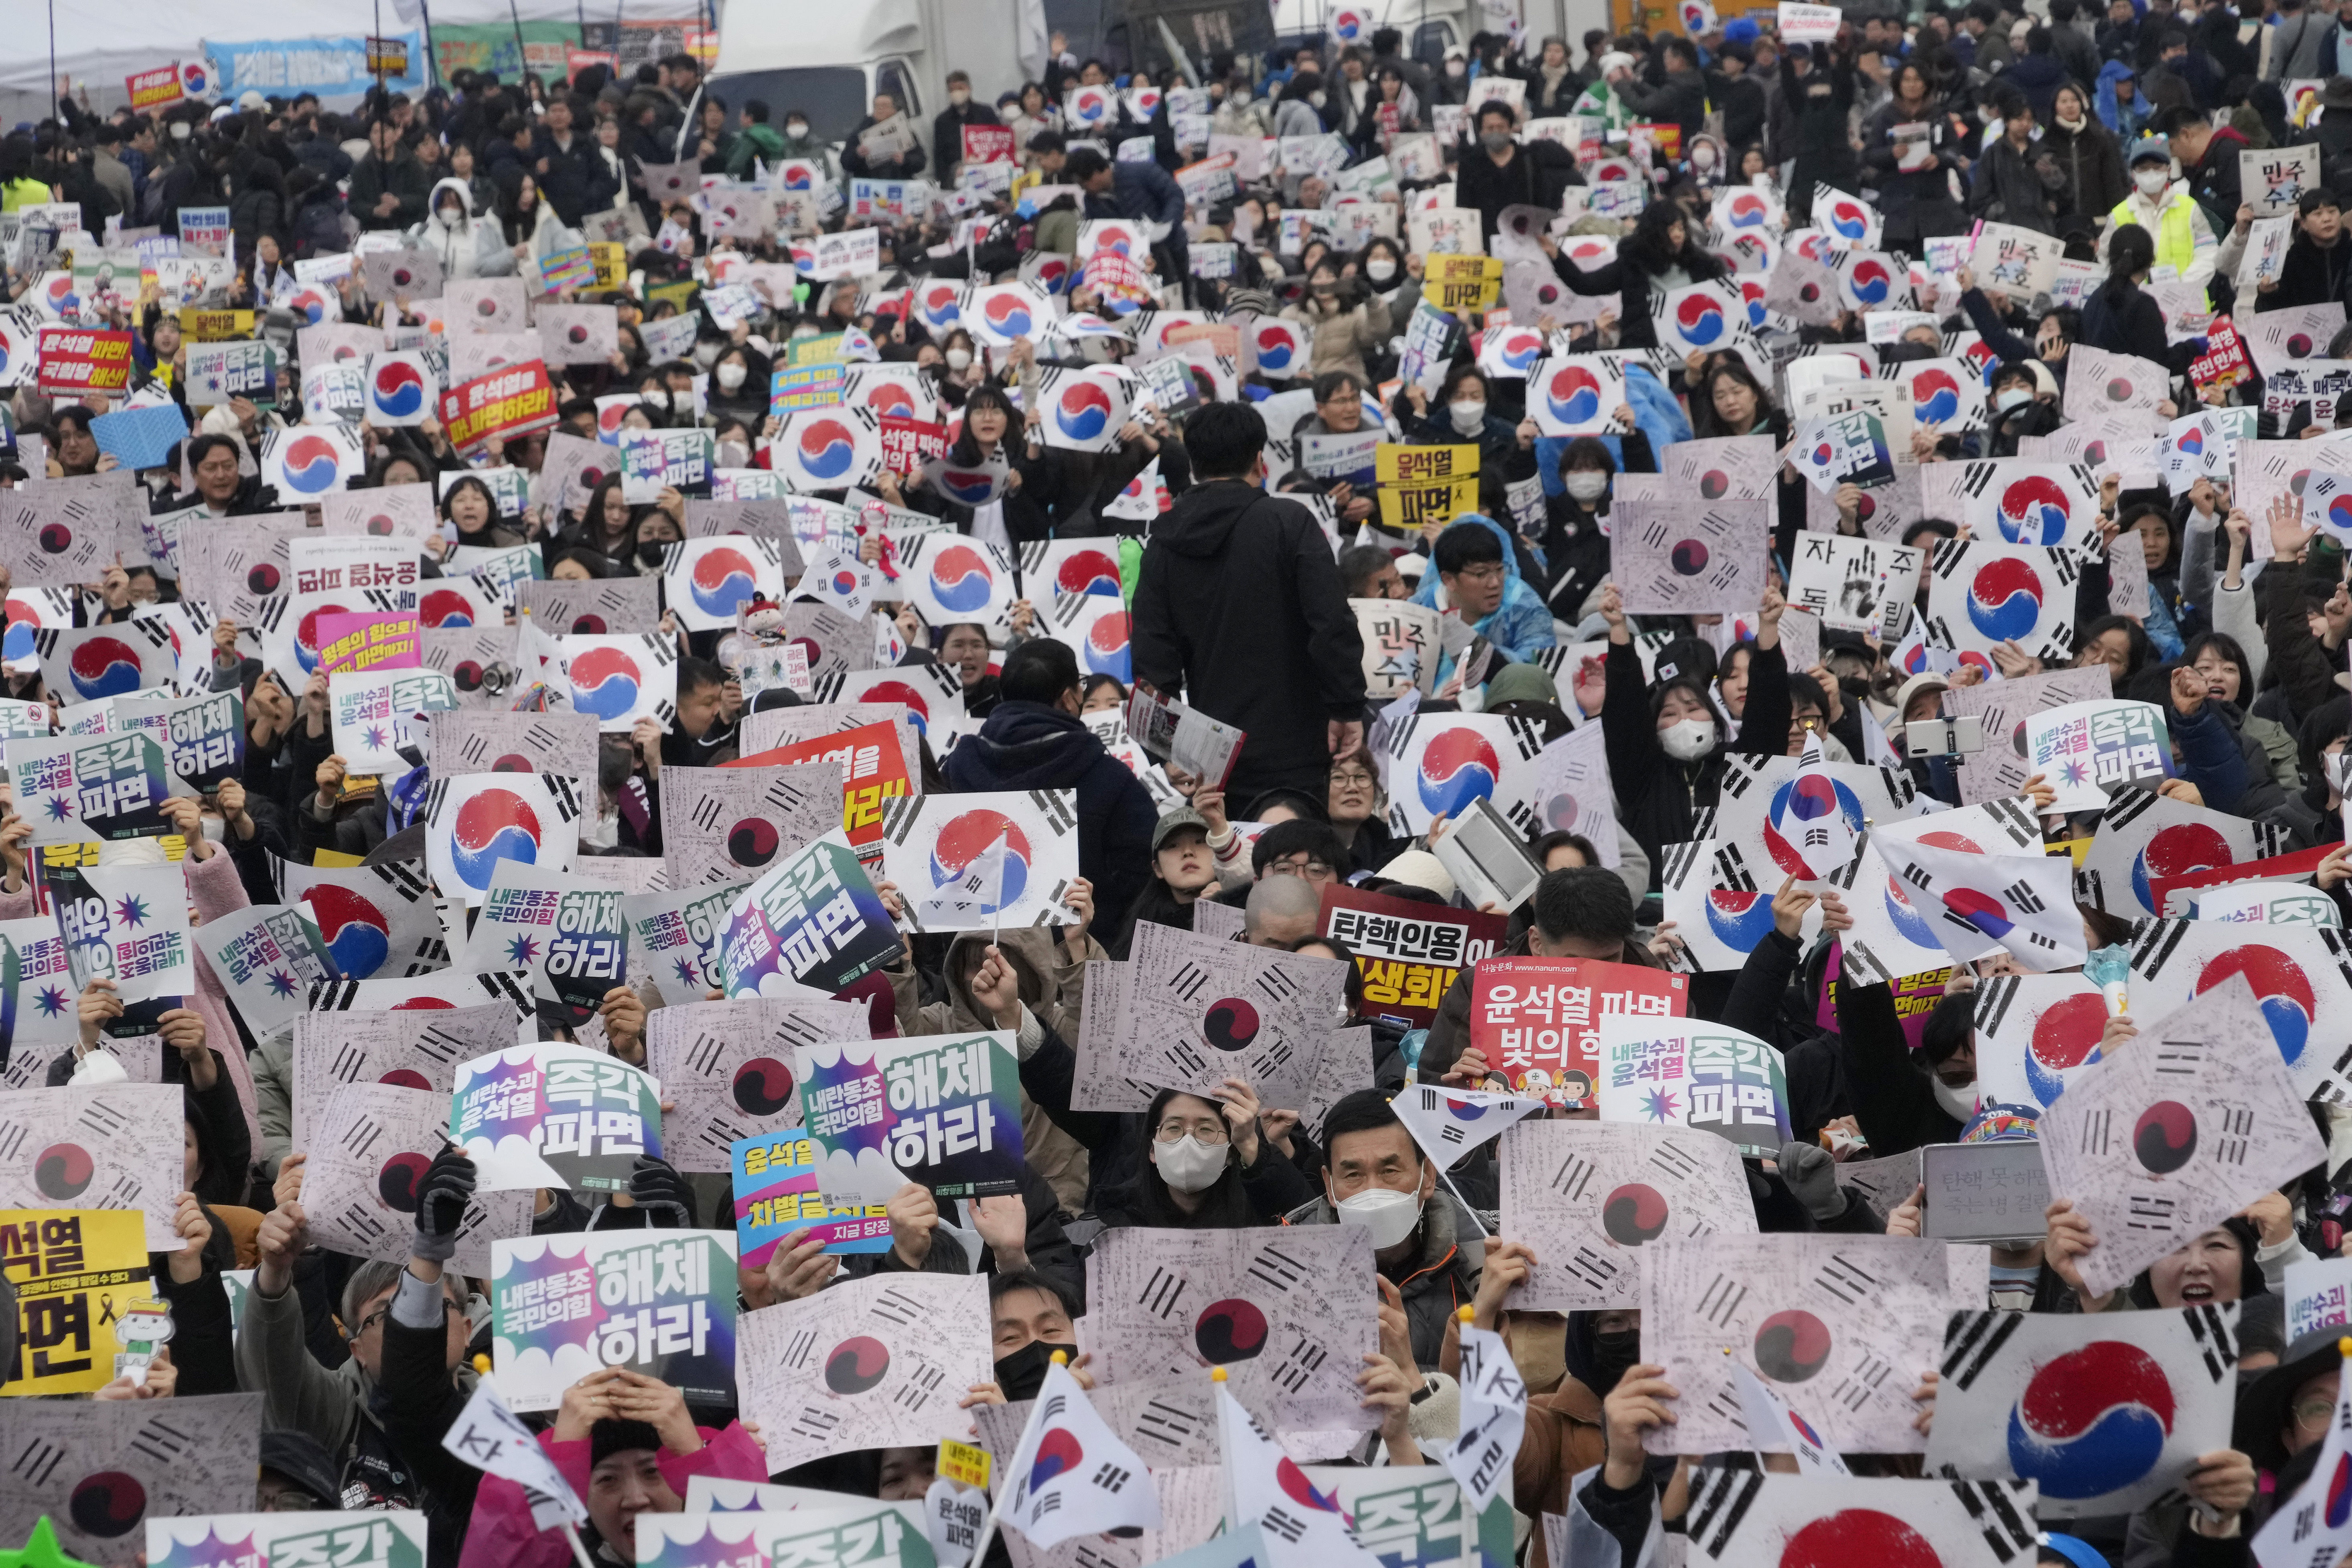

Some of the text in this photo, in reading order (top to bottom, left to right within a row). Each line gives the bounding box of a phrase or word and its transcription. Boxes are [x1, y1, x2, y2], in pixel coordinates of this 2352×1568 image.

[2263, 160, 2305, 185] 민주
[2263, 184, 2305, 209] 수호
[1999, 238, 2039, 264] 민주
[1446, 260, 1483, 277] 윤석열
[1991, 263, 2031, 289] 수호
[1444, 283, 1481, 306] 파면
[197, 314, 235, 332] 윤석열
[2207, 327, 2236, 350] 혁명
[42, 334, 129, 360] 윤석열 파면!
[227, 344, 266, 371] 즉각
[2189, 345, 2243, 380] 국민 만세
[42, 361, 127, 386] 국힘당 해산!
[227, 368, 265, 392] 파면
[778, 371, 810, 387] 윤석열
[2268, 375, 2308, 394] 매국노
[468, 371, 536, 409] 윤석열을
[470, 388, 550, 435] 파면하라!
[2220, 409, 2245, 436] 각
[665, 433, 705, 461] 즉각
[882, 428, 945, 460] 석열 파면
[666, 458, 705, 486] 파면
[1398, 448, 1453, 479] 윤석열
[1399, 487, 1451, 525] 파면
[486, 547, 533, 583] 즉각
[1807, 538, 1915, 575] 자 주
[1884, 601, 1904, 627] 립
[321, 619, 417, 665] 평등의 힘으로!
[1372, 617, 1426, 655] 민주
[355, 639, 414, 670] 파면까지!
[339, 686, 390, 710] 내란수괴
[393, 675, 450, 713] 즉각
[122, 714, 166, 731] 내란동조
[170, 694, 232, 745] 해체
[340, 700, 391, 726] 윤석열
[2090, 706, 2155, 746] 즉각
[2036, 716, 2086, 748] 내란수괴
[76, 736, 147, 784] 즉각
[172, 733, 236, 776] 하라
[2037, 732, 2089, 767] 윤석열
[2096, 741, 2164, 785] 파면
[18, 753, 71, 779] 내란수괴
[20, 767, 73, 798] 윤석열
[80, 773, 151, 820] 파면
[490, 888, 560, 908] 내란동조
[763, 846, 842, 933] 즉각
[485, 905, 555, 926] 국민의힘
[559, 892, 623, 935] 해체
[636, 910, 683, 936] 내란동조
[20, 936, 64, 963] 란동조
[218, 923, 266, 965] 내란수괴
[643, 927, 689, 952] 국민의힘
[722, 910, 762, 973] 내란수괴
[779, 888, 866, 980] 파면
[19, 954, 69, 982] 민의힘
[229, 939, 282, 986] 윤석열
[545, 933, 620, 980] 하라
[725, 926, 772, 991] 윤석열
[1481, 961, 1577, 974] 나눔문화 www.nanum.com
[1484, 984, 1672, 1025] 윤석열 파면
[1500, 1027, 1569, 1068] 빛의
[1613, 1037, 1685, 1062] 내란수괴
[1691, 1037, 1772, 1086] 즉각
[545, 1061, 642, 1113] 즉각
[886, 1040, 993, 1110] 해체
[1612, 1056, 1683, 1087] 윤석열
[462, 1071, 538, 1111] 내란수괴
[808, 1074, 882, 1114] 내란동조
[1690, 1082, 1777, 1127] 파면
[461, 1092, 536, 1134] 윤석열
[813, 1097, 884, 1136] 국민의힘
[542, 1111, 644, 1156] 파면
[891, 1099, 996, 1168] 하라
[936, 1187, 963, 1196] 비상행동
[1942, 1169, 1983, 1193] 탄핵
[1988, 1167, 2011, 1189] 못
[1989, 1195, 2008, 1216] 병
[833, 1219, 890, 1240] 지금 당장
[0, 1215, 85, 1278] 석열
[50, 1277, 79, 1293] 안전을
[99, 1274, 109, 1286] 수
[109, 1272, 129, 1284] 없다
[598, 1239, 711, 1306] 해체
[501, 1267, 592, 1311] 내란동조
[2290, 1284, 2346, 1324] 내란수괴
[503, 1292, 592, 1335] 국민의힘
[600, 1300, 711, 1367] 하라
[939, 1497, 981, 1529] 윤석열
[945, 1524, 975, 1550] 파면
